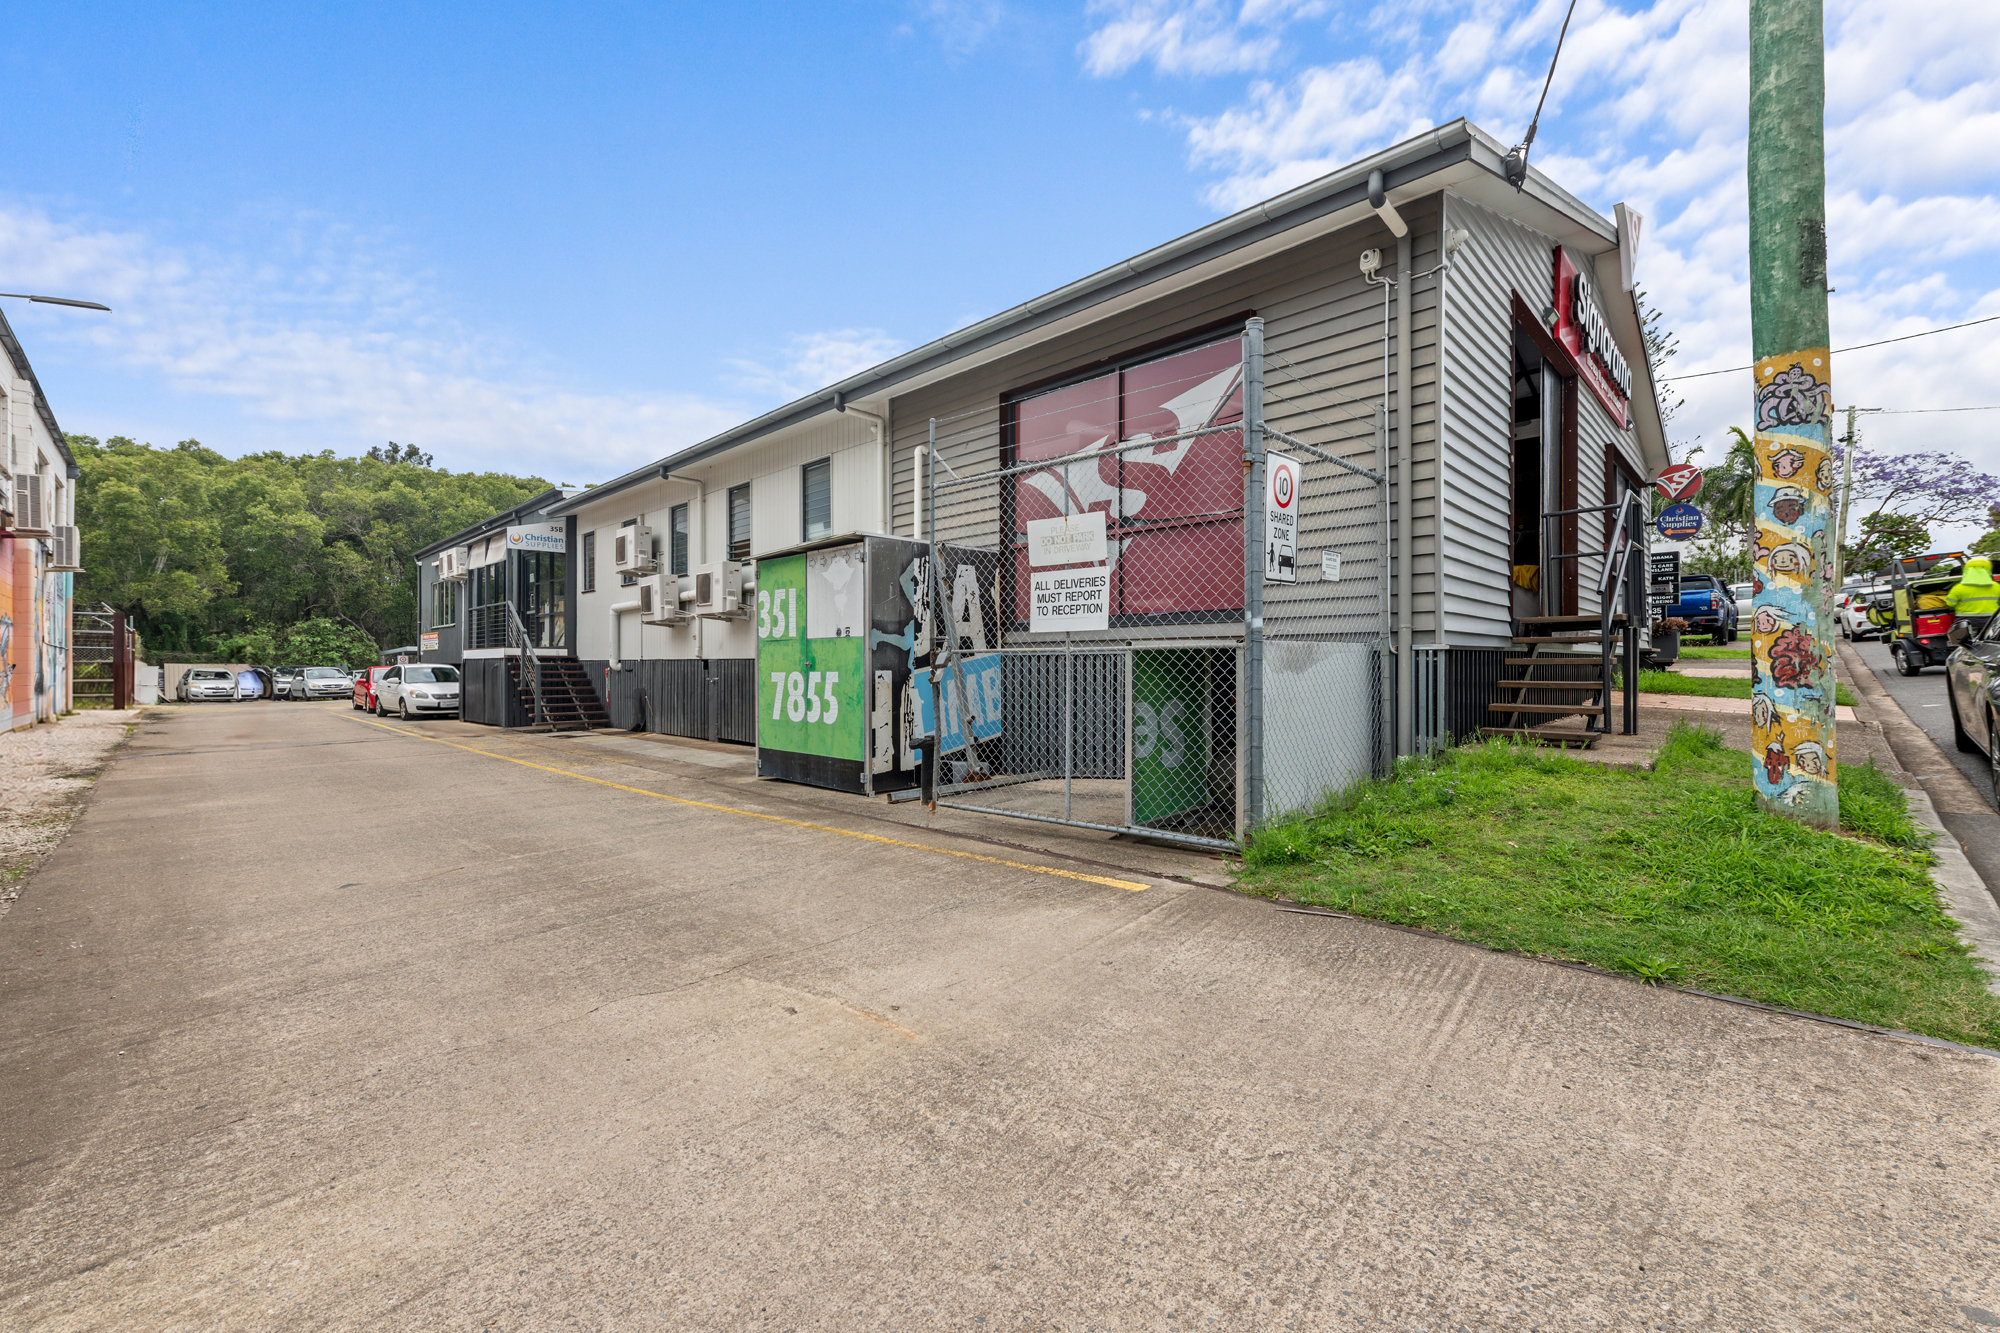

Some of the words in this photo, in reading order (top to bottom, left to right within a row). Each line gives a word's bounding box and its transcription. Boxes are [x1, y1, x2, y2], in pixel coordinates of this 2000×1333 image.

[1577, 271, 1632, 400] Signarama
[1279, 476, 1288, 496] 10
[1270, 510, 1294, 526] SHARED
[1660, 514, 1699, 522] Christian
[1661, 520, 1697, 529] Supplies
[1050, 524, 1080, 535] PLEASE
[1273, 527, 1289, 541] ZONE
[525, 533, 564, 543] Christian
[1041, 537, 1052, 546] DO
[1054, 535, 1071, 545] NOT
[1073, 532, 1094, 542] PARK
[525, 541, 564, 550] SUPPLIES
[1043, 547, 1052, 555] IN
[1053, 543, 1092, 554] DRIVEWAY
[1034, 581, 1051, 591] ALL
[1054, 576, 1106, 590] DELIVERIES
[1037, 592, 1062, 604] MUST
[1065, 590, 1102, 602] REPORT
[758, 588, 797, 639] 351
[1036, 606, 1049, 616] TO
[1052, 603, 1103, 616] RECEPTION
[771, 671, 840, 725] 7855
